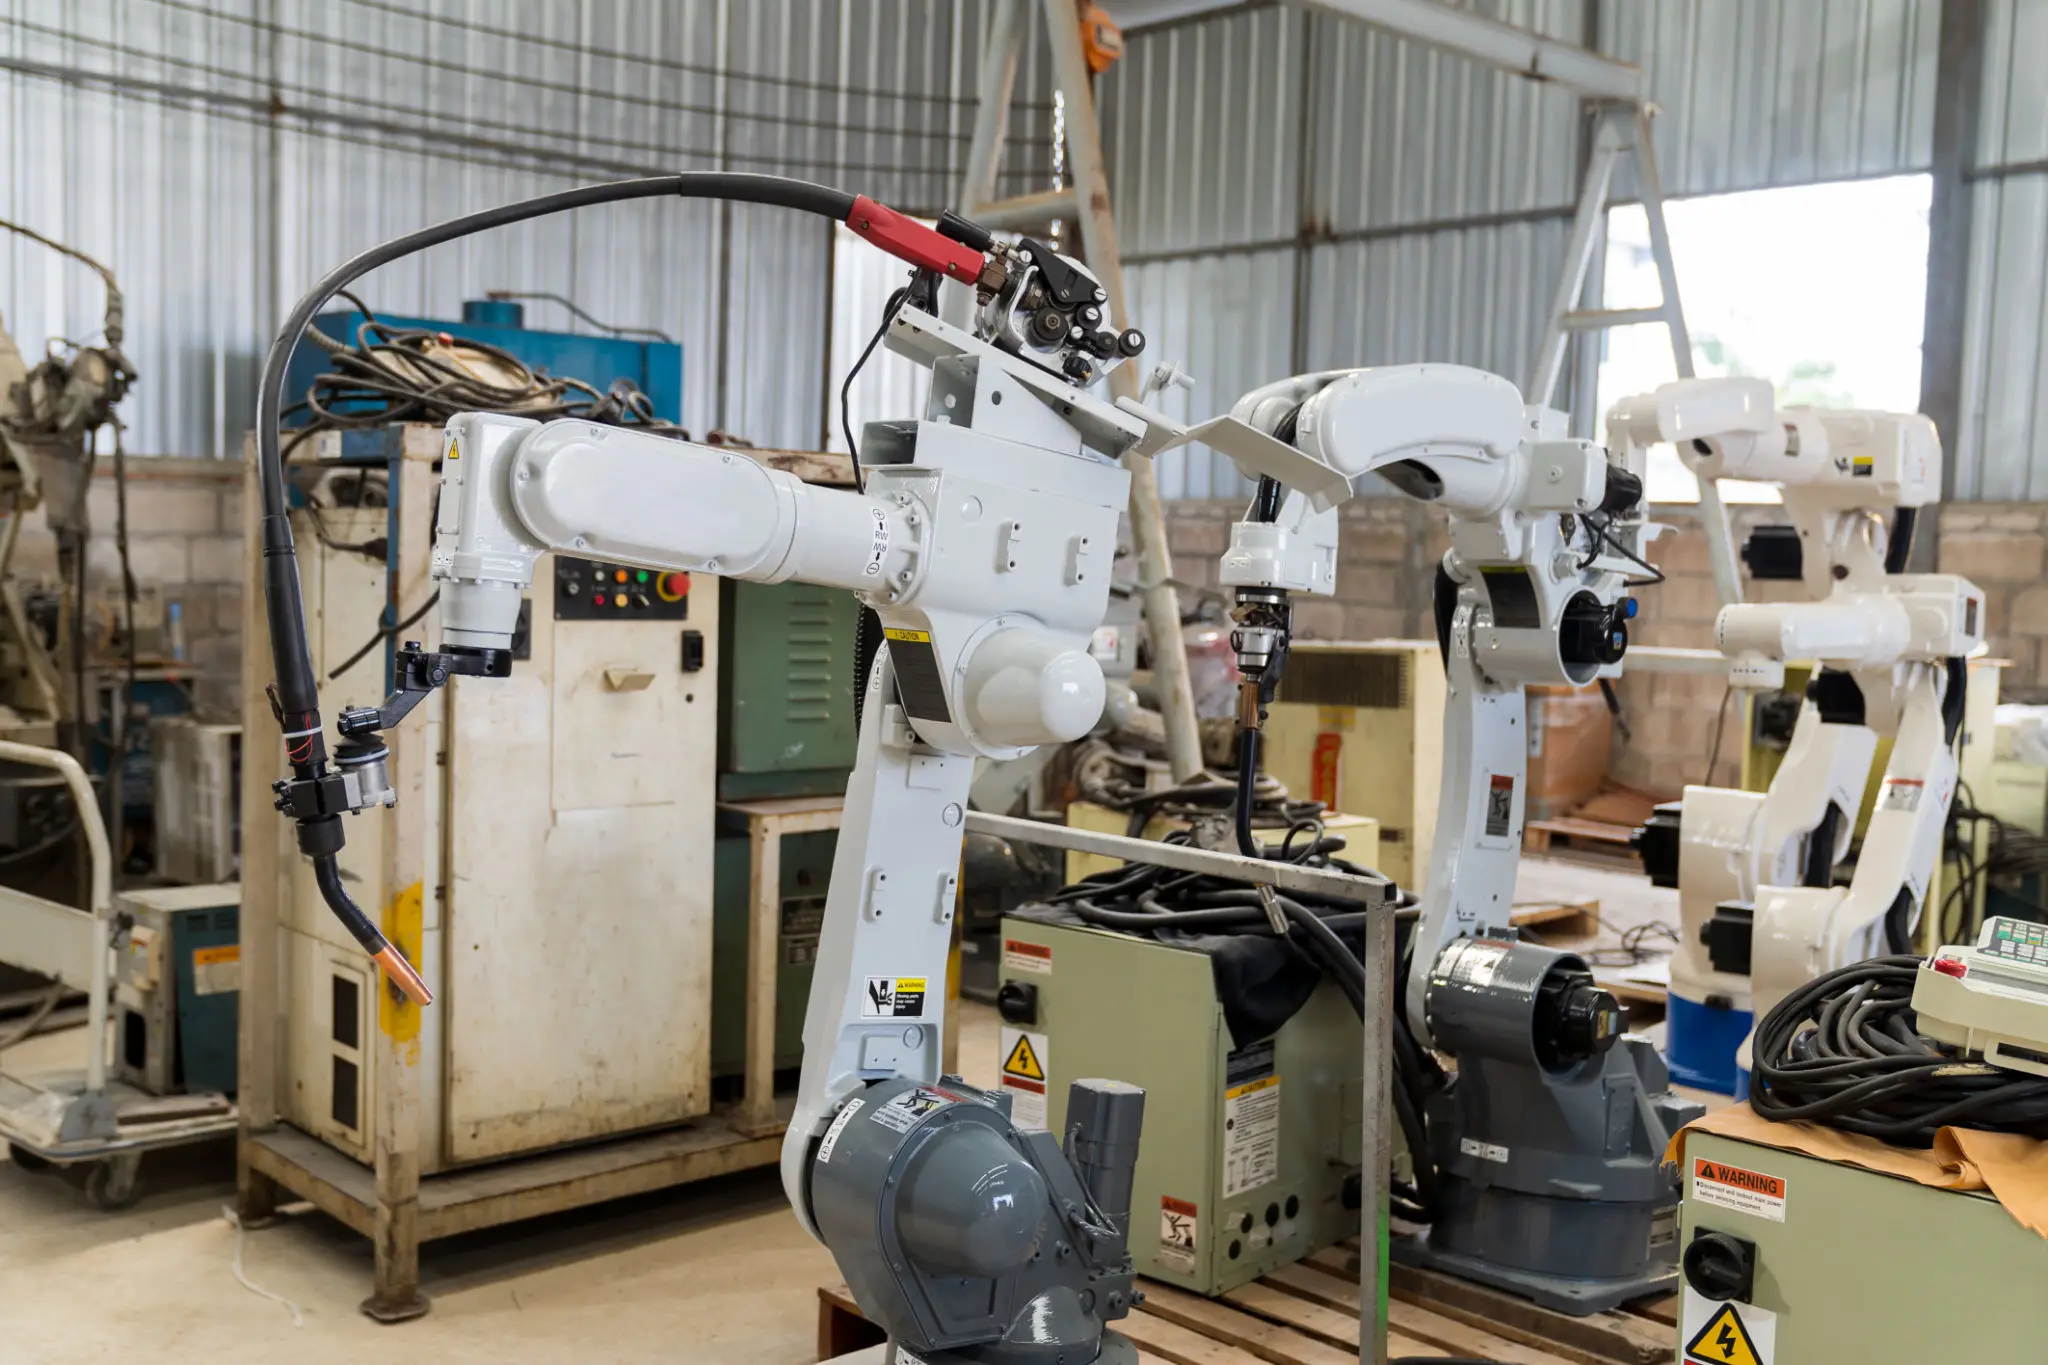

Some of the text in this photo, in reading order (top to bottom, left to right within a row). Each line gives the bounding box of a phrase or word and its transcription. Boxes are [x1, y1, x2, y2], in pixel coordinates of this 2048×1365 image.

[874, 530, 889, 541] RW
[899, 631, 920, 641] CAUTION
[1718, 1167, 1777, 1194] WARNING
